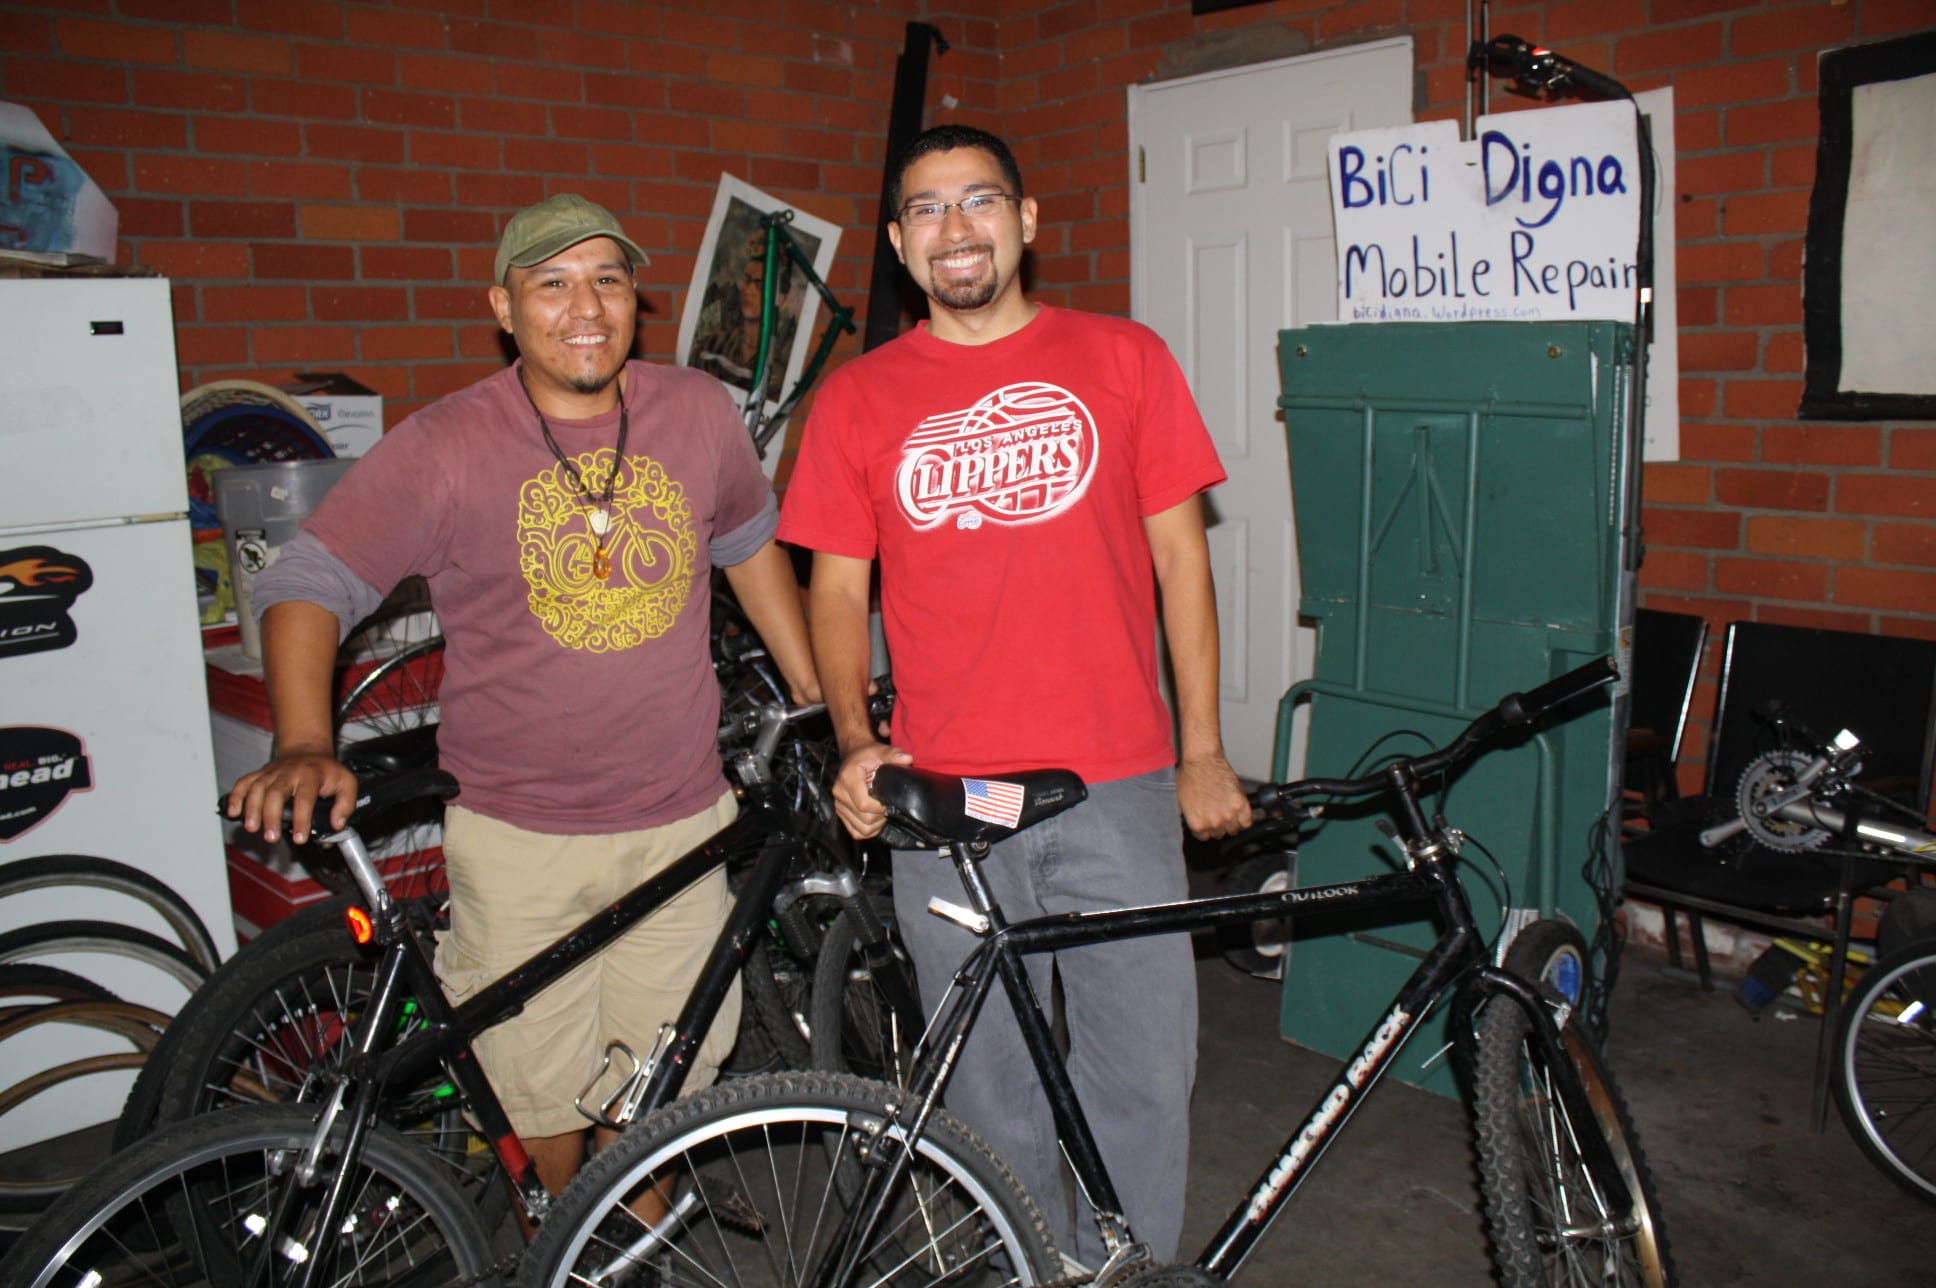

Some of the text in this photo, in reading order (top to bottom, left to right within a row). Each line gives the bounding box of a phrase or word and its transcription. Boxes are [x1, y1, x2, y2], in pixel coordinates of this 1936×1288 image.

[1511, 230, 1638, 311] Repair
[960, 418, 1083, 453] LOS ANGELES
[898, 435, 1080, 521] CLIPPERS
[1281, 886, 1359, 903] OUTLOOK
[1248, 1003, 1411, 1224] DIAMOND BACK
